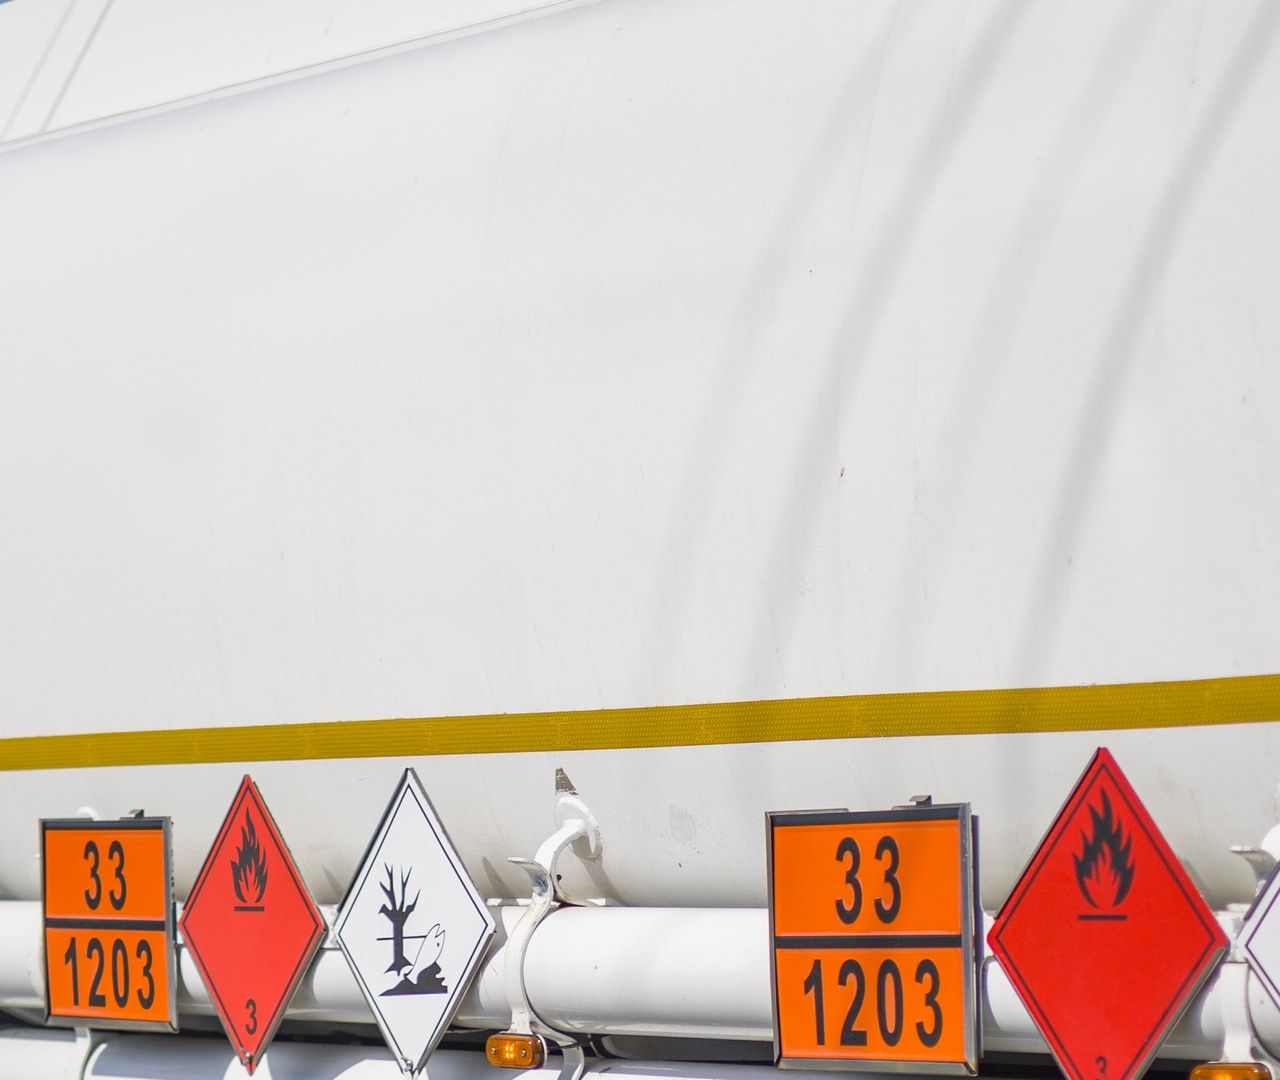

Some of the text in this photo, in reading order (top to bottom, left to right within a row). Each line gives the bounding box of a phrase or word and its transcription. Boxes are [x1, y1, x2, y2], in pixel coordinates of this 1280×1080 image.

[83, 840, 127, 911] 33
[835, 835, 902, 925] 33
[65, 936, 155, 1011] 1203
[803, 958, 943, 1048] 1203
[245, 998, 258, 1036] 3
